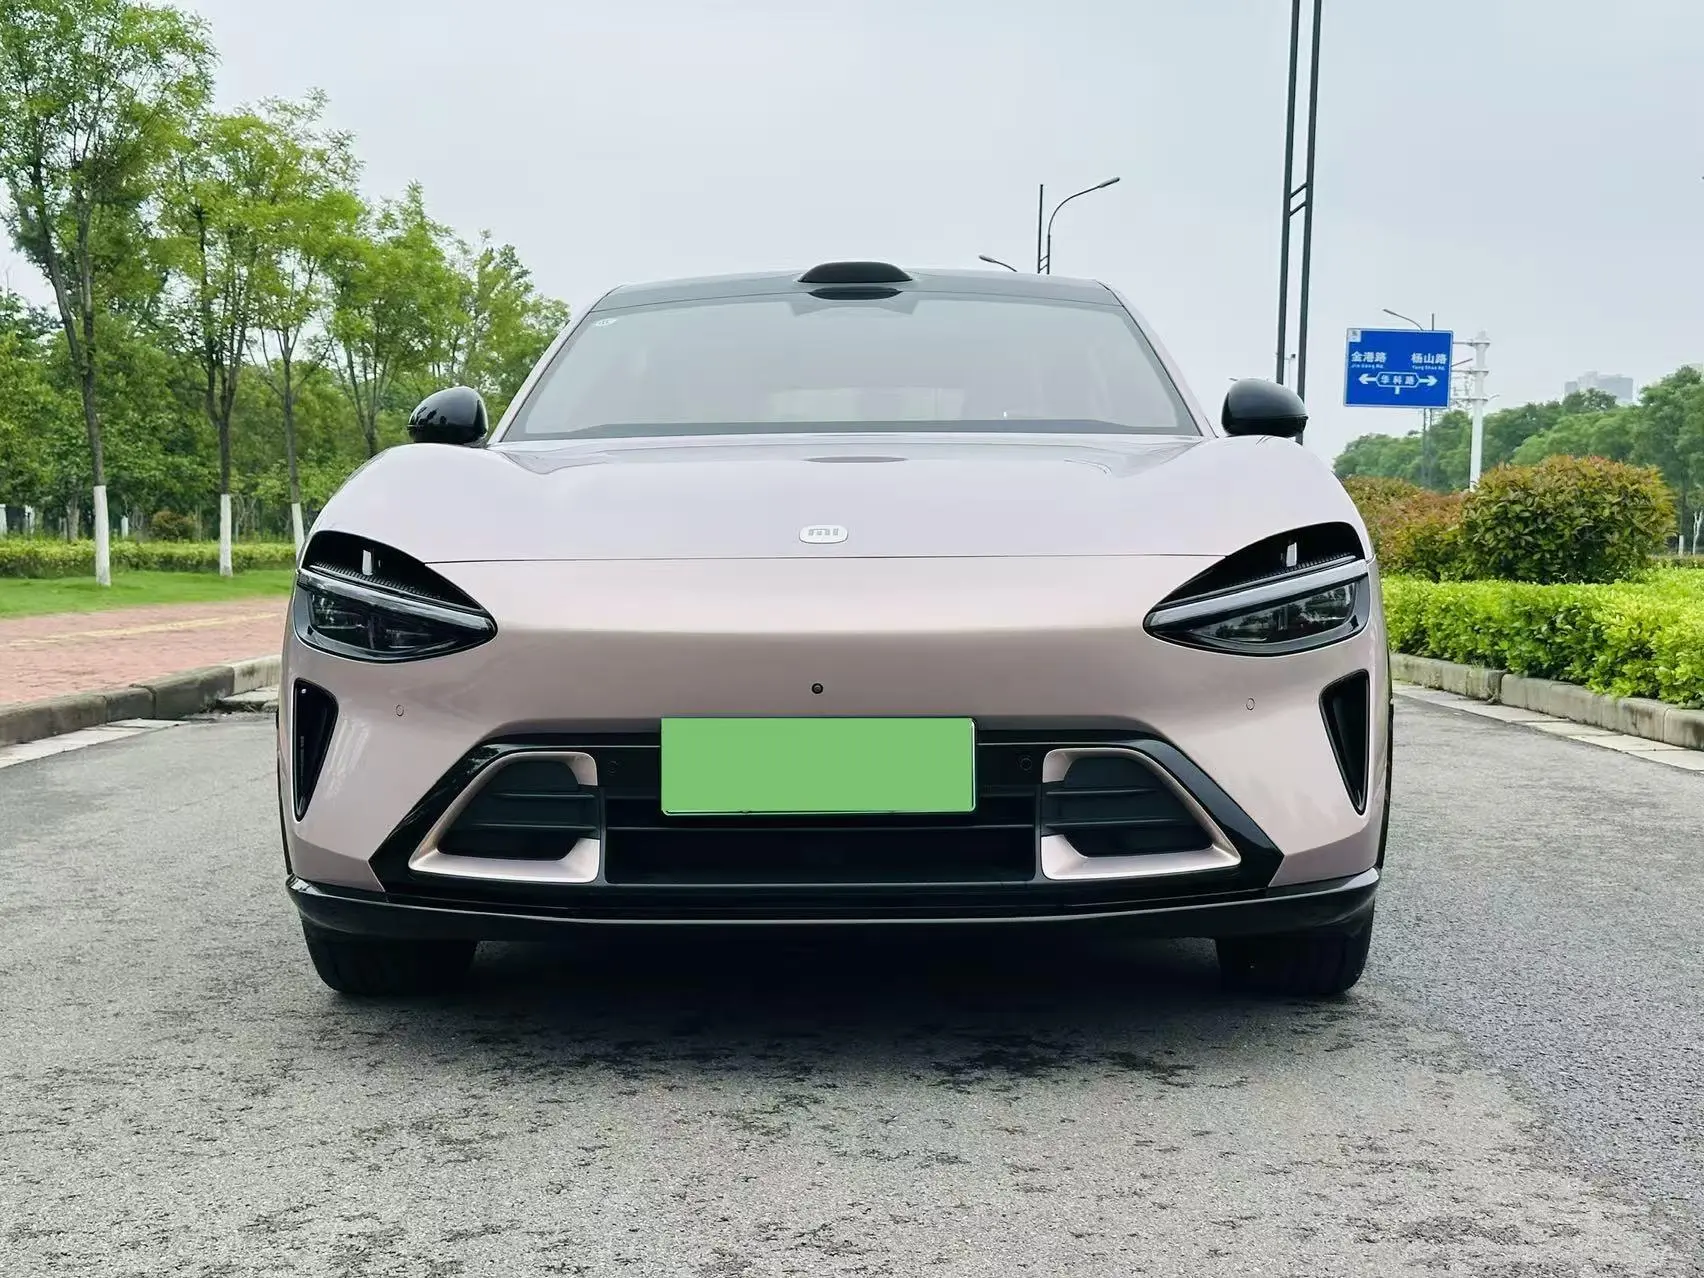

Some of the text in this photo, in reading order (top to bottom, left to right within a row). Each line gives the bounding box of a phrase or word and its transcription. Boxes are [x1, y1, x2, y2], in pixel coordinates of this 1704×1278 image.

[1351, 351, 1386, 363] 金港路
[1411, 352, 1447, 364] 杨山路
